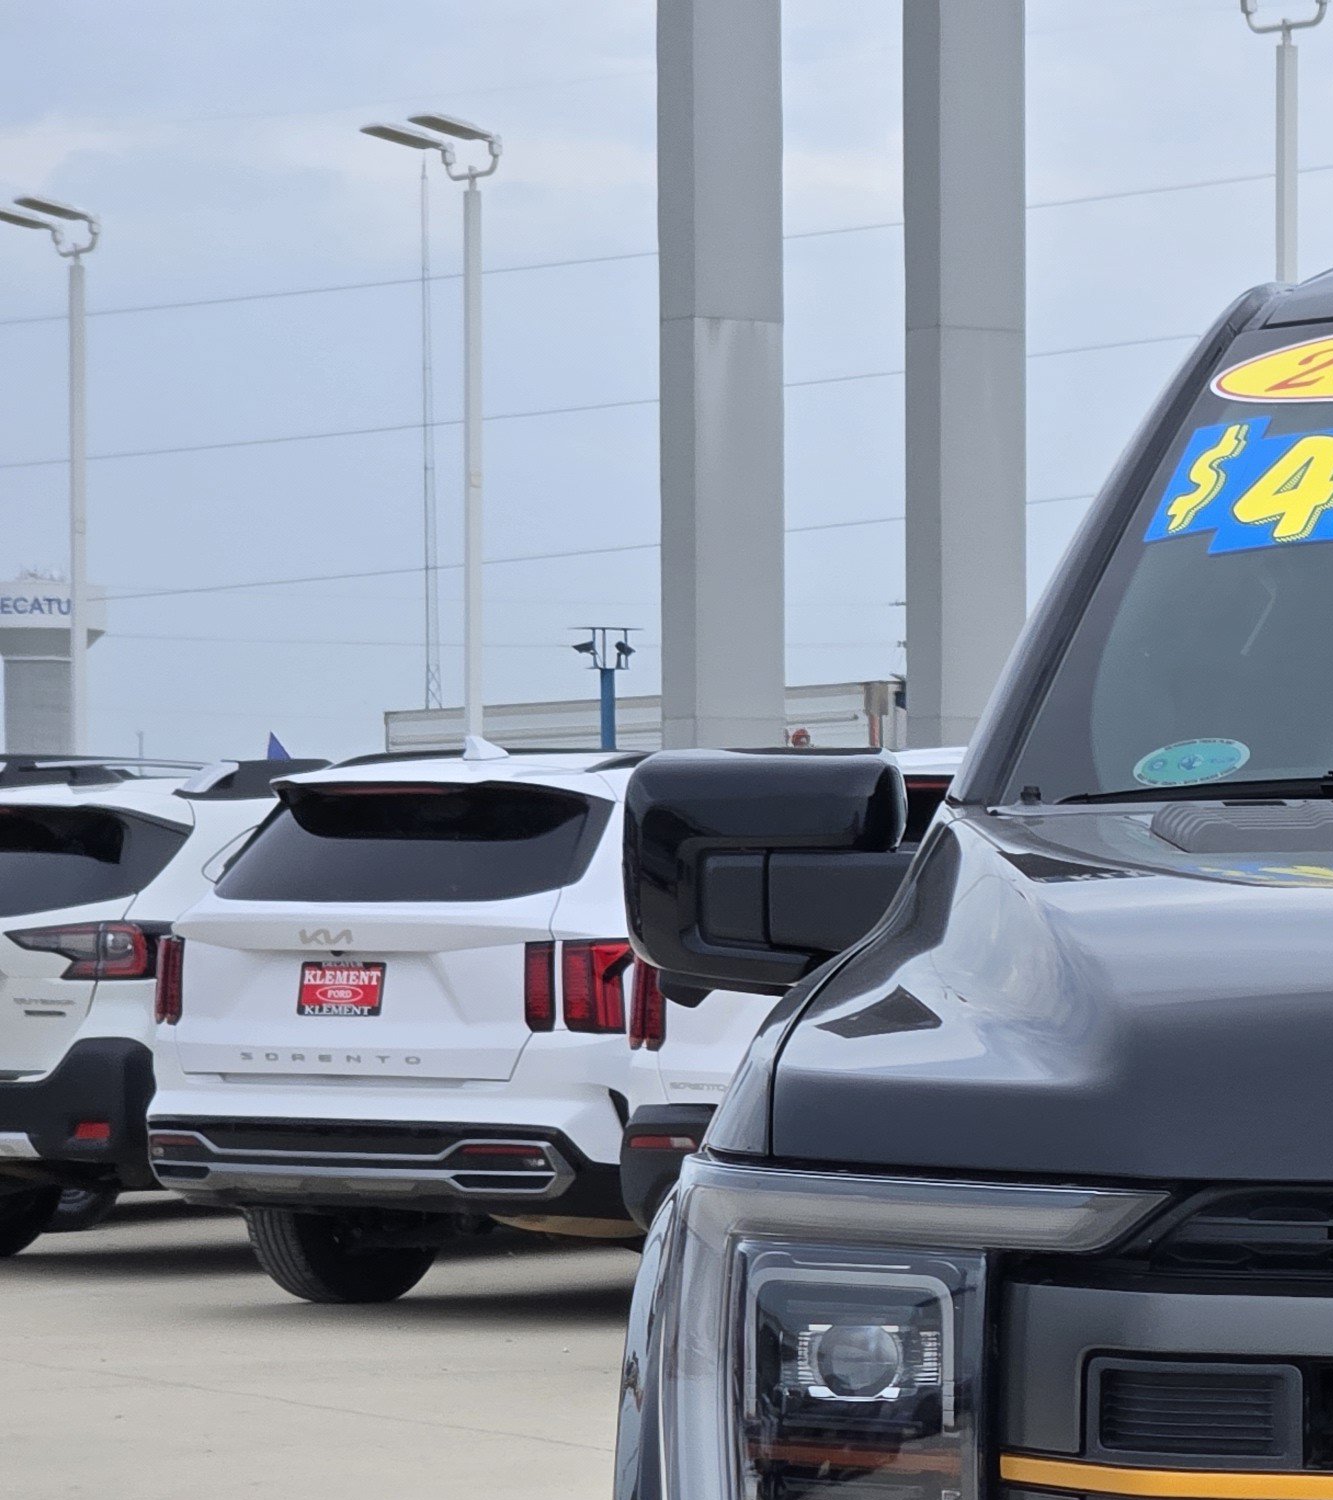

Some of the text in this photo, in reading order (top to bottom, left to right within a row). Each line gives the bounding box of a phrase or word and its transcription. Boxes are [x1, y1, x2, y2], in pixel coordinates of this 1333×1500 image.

[0, 597, 71, 615] ECATU
[304, 970, 381, 985] KLEMENT
[327, 989, 352, 998] FORD
[304, 1004, 371, 1015] KLEMENT
[240, 1051, 421, 1065] SORENTO
